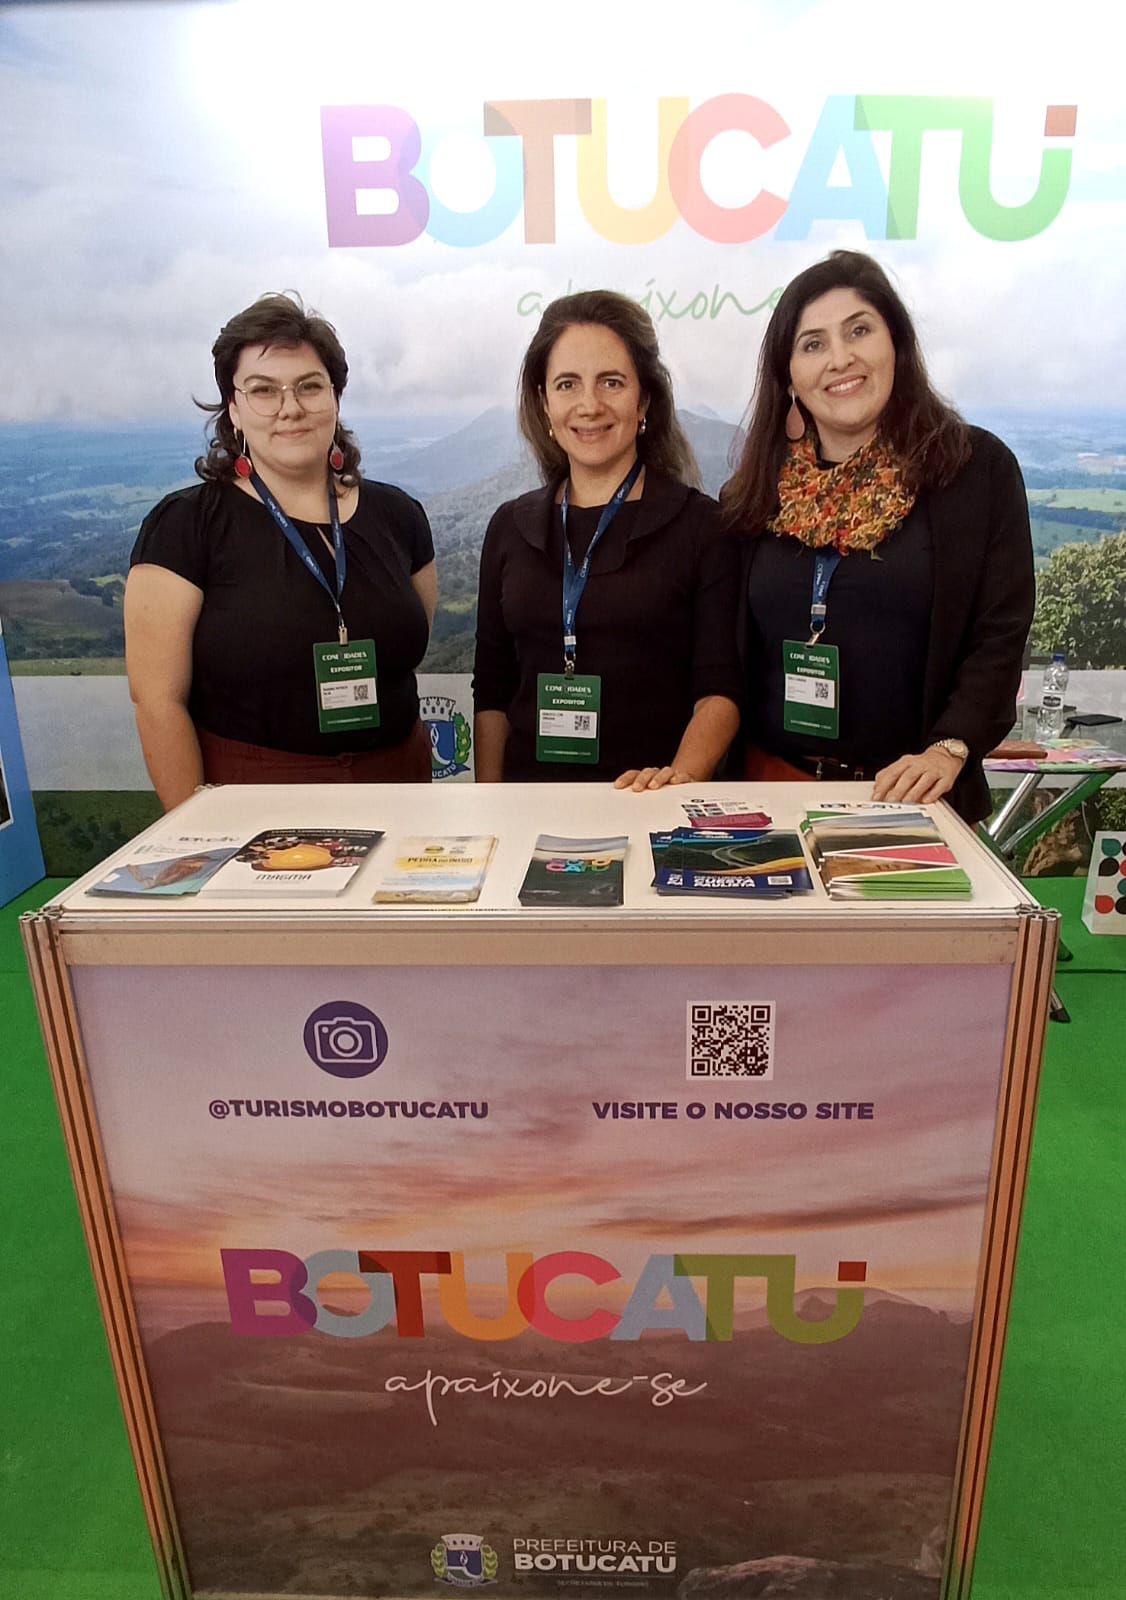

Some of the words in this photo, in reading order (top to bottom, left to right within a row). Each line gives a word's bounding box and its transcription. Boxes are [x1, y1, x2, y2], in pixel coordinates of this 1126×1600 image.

[321, 93, 1077, 248] BOTUCATU
[209, 1100, 489, 1119] @TURISMOBOTUCATU
[592, 1102, 678, 1119] VISITE
[686, 1102, 706, 1119] O
[714, 1102, 807, 1119] NOSSO
[815, 1102, 874, 1119] SITE
[220, 1249, 867, 1344] BOTUCATU
[385, 1369, 707, 1426] apaixone-se
[513, 1538, 641, 1553] PREFEITURA
[649, 1541, 676, 1554] DE
[514, 1553, 676, 1573] BOTUCATU
